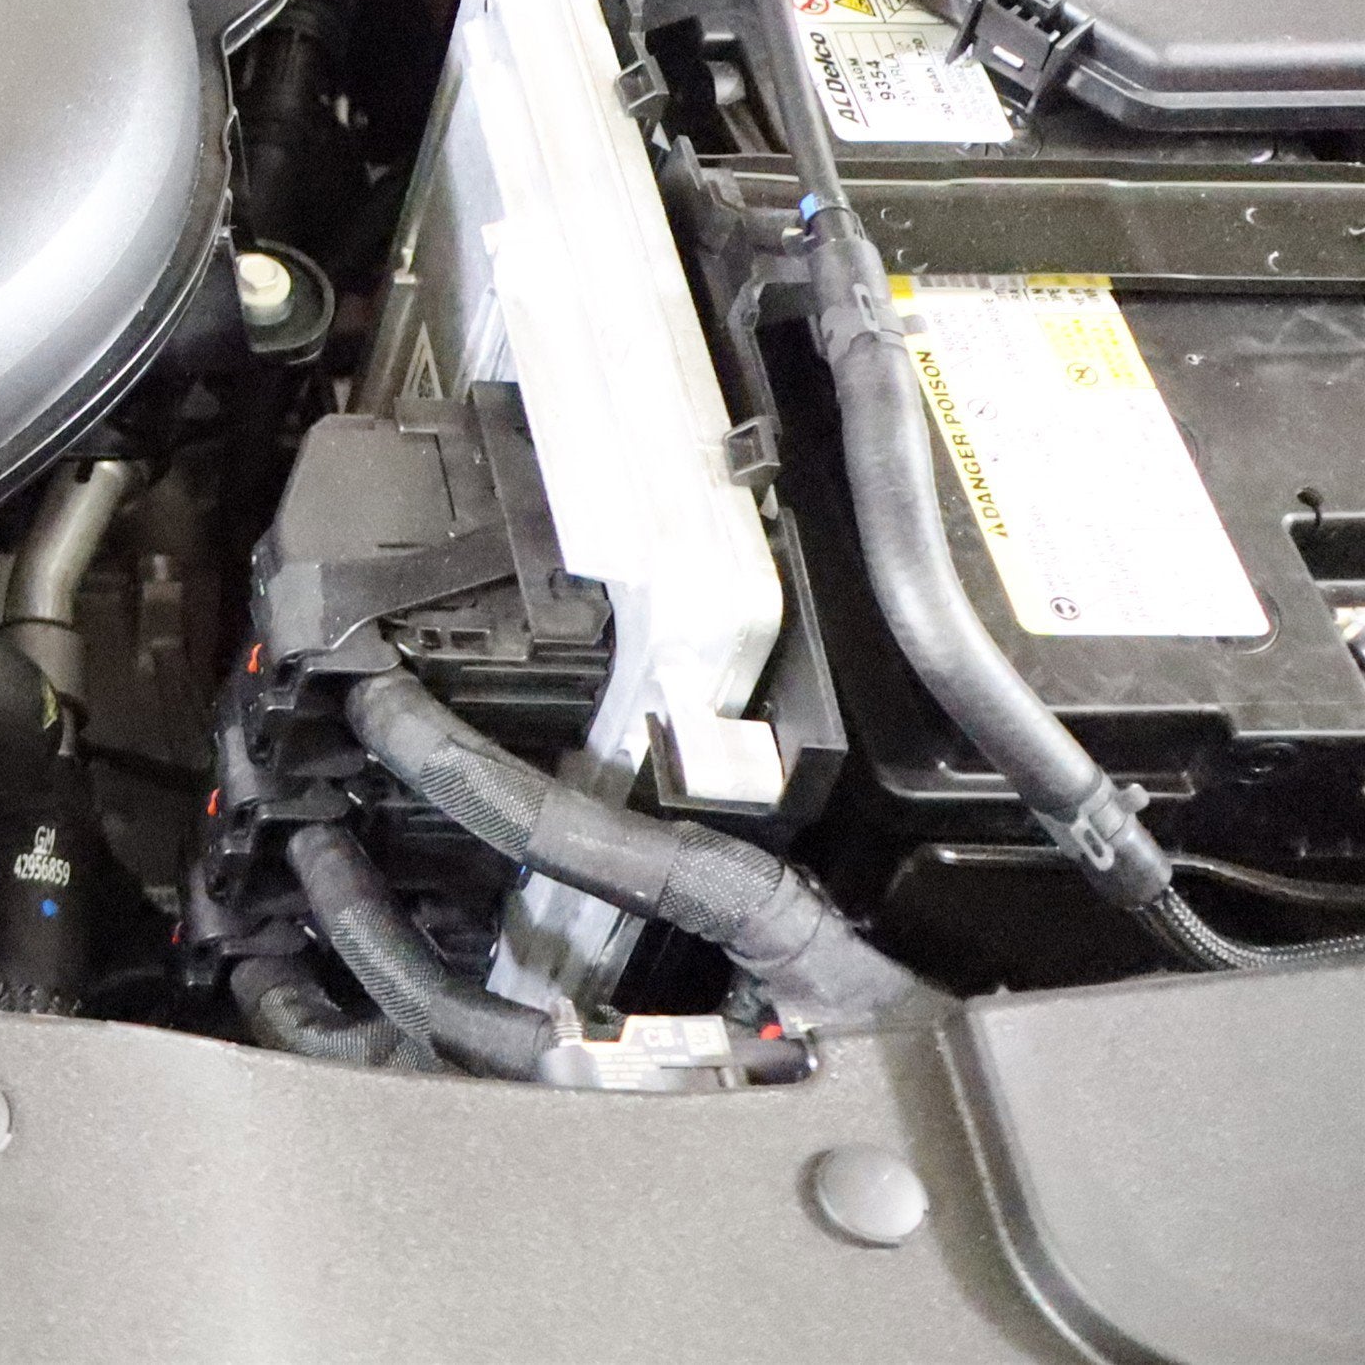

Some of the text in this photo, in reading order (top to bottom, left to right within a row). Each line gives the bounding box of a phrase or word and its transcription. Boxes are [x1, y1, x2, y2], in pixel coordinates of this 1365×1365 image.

[810, 32, 860, 124] ACDelco
[866, 59, 896, 101] 9354
[34, 825, 56, 854] GM
[13, 852, 71, 887] 42956859
